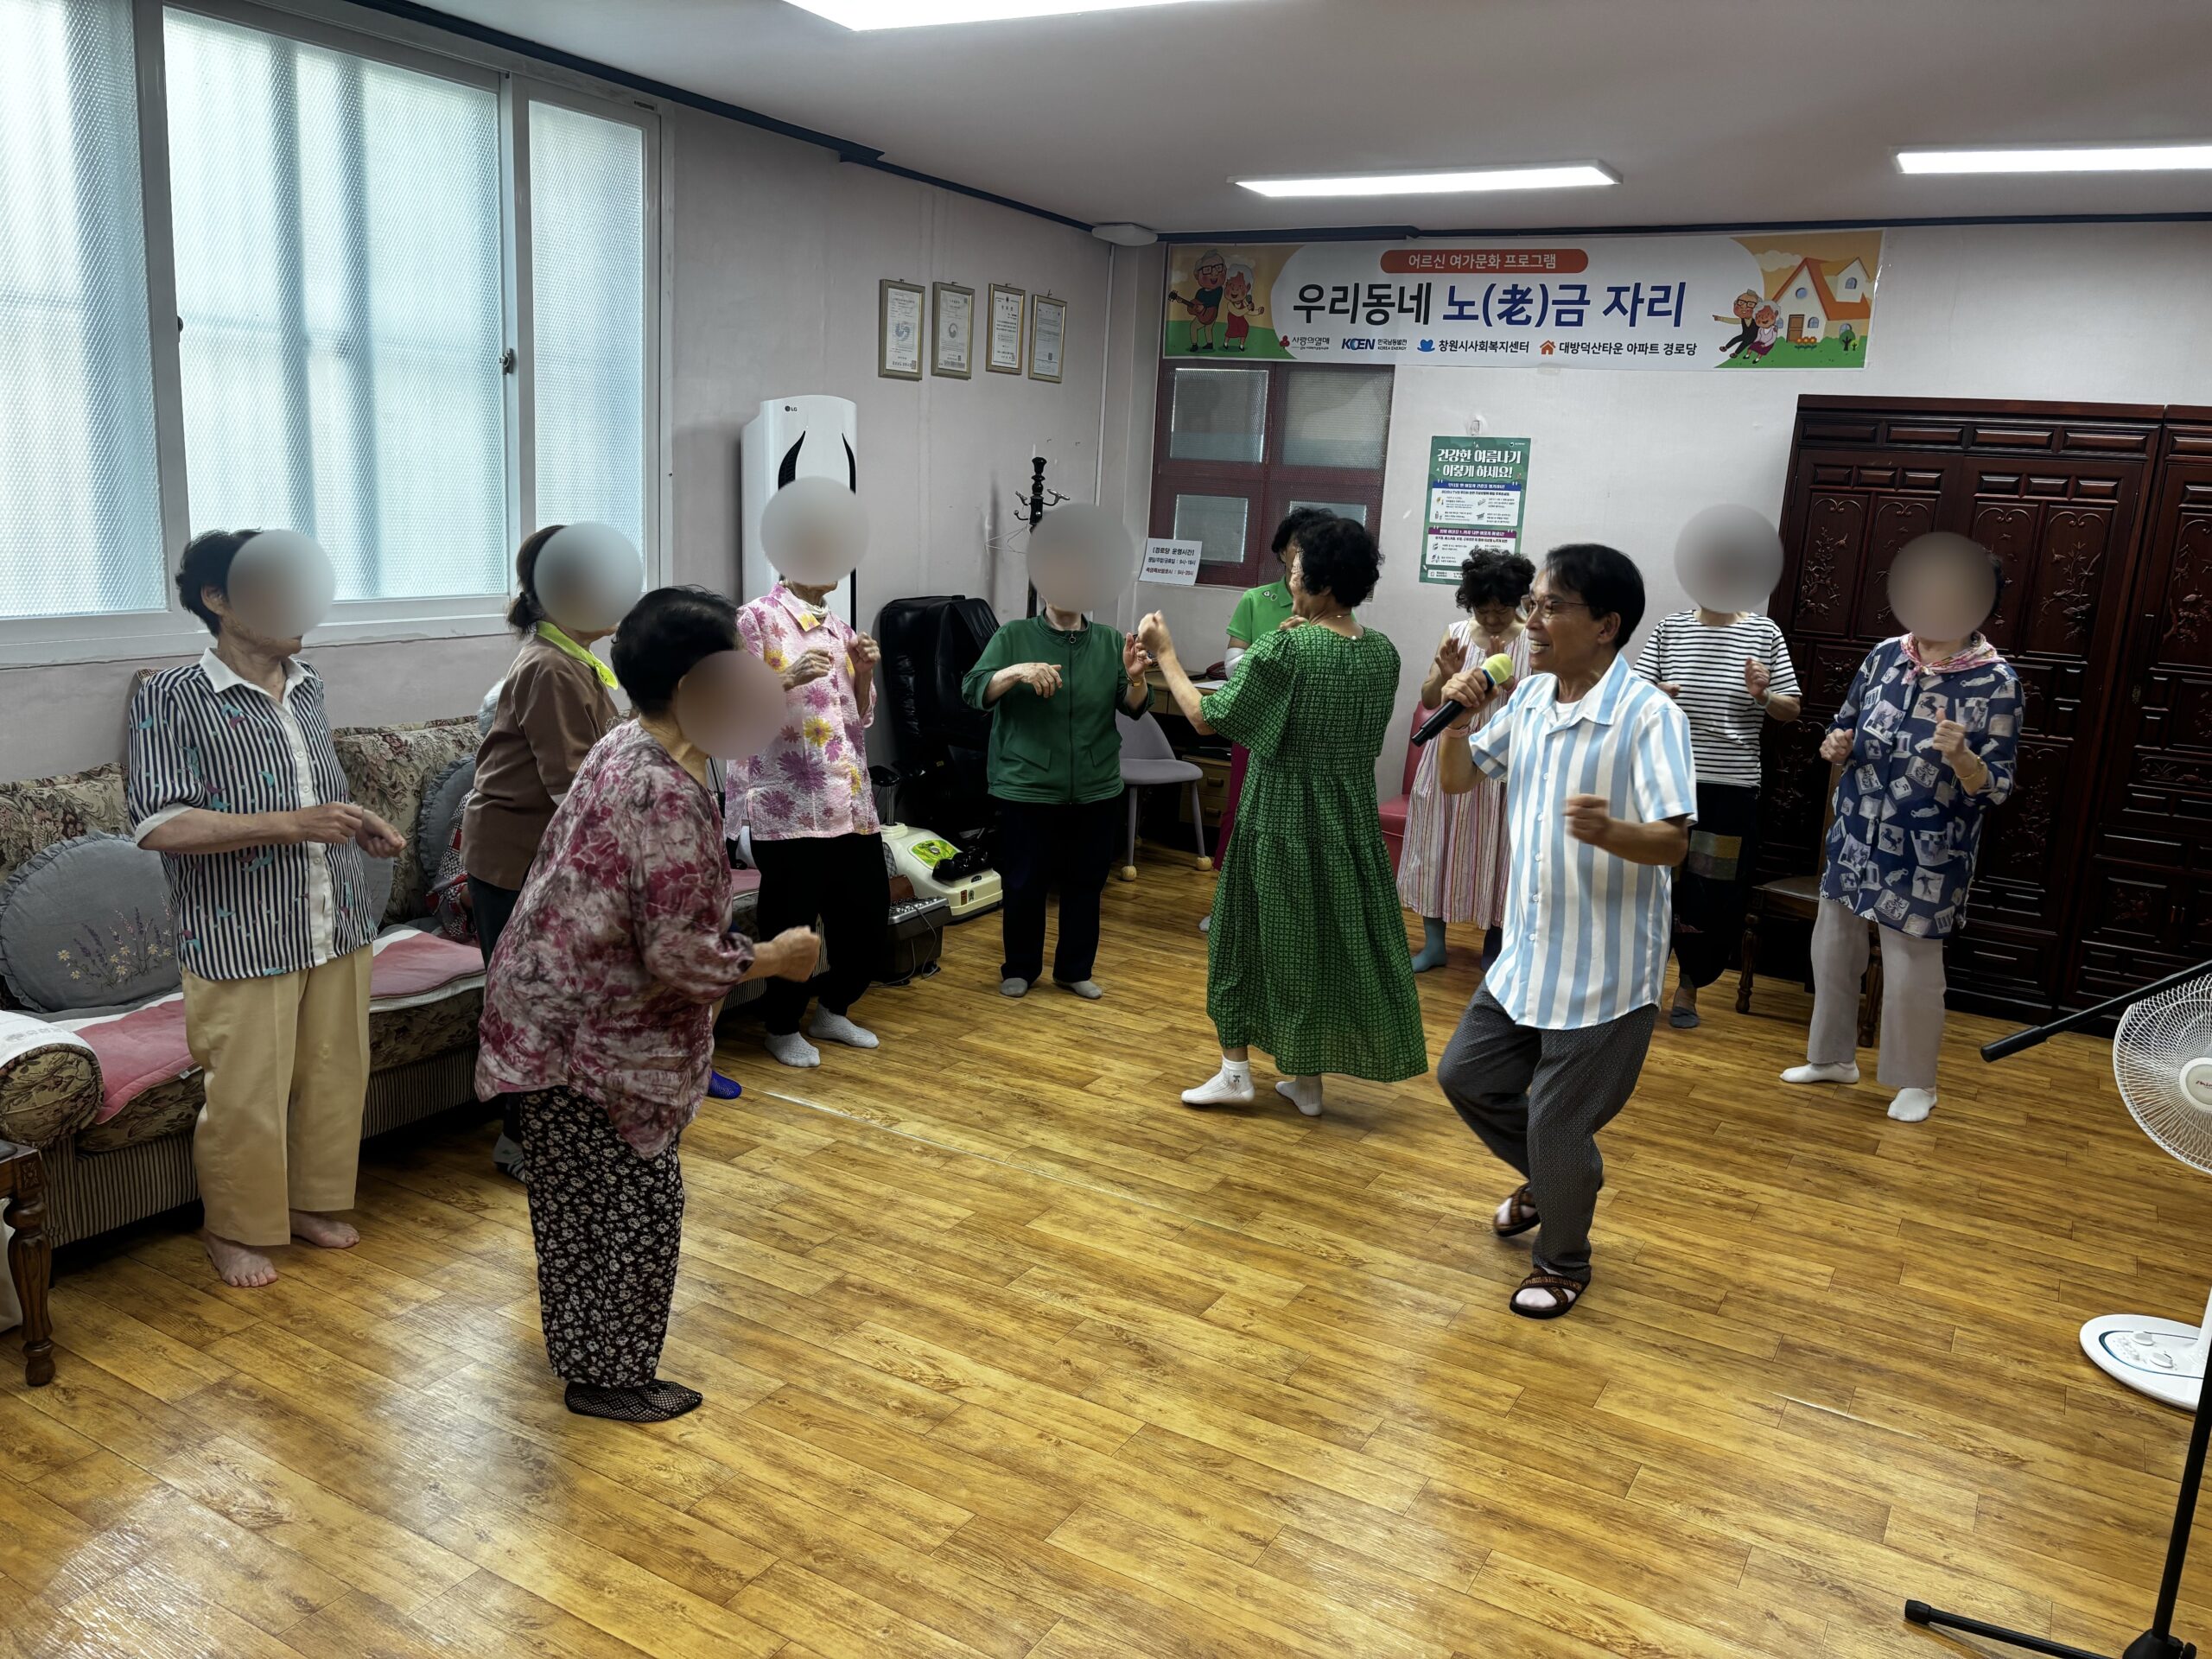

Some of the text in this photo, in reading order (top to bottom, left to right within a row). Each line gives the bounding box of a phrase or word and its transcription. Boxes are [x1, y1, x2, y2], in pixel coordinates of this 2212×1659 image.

[1408, 253, 1556, 270] 어르신 여가문화 프로그램
[1293, 281, 1686, 327] 우리동네 노(老)금 자리
[1292, 336, 1330, 346] 사랑의열매
[1341, 338, 1376, 351] KOEN
[1377, 338, 1408, 346] 한국남동발전
[1439, 339, 1529, 353] 창원시사회복지센터
[1559, 341, 1697, 356] 대방덕산타운 아파트 경로당
[1437, 448, 1522, 464] 건강한 여름나기
[1442, 464, 1513, 478] 이렇게 하세요!
